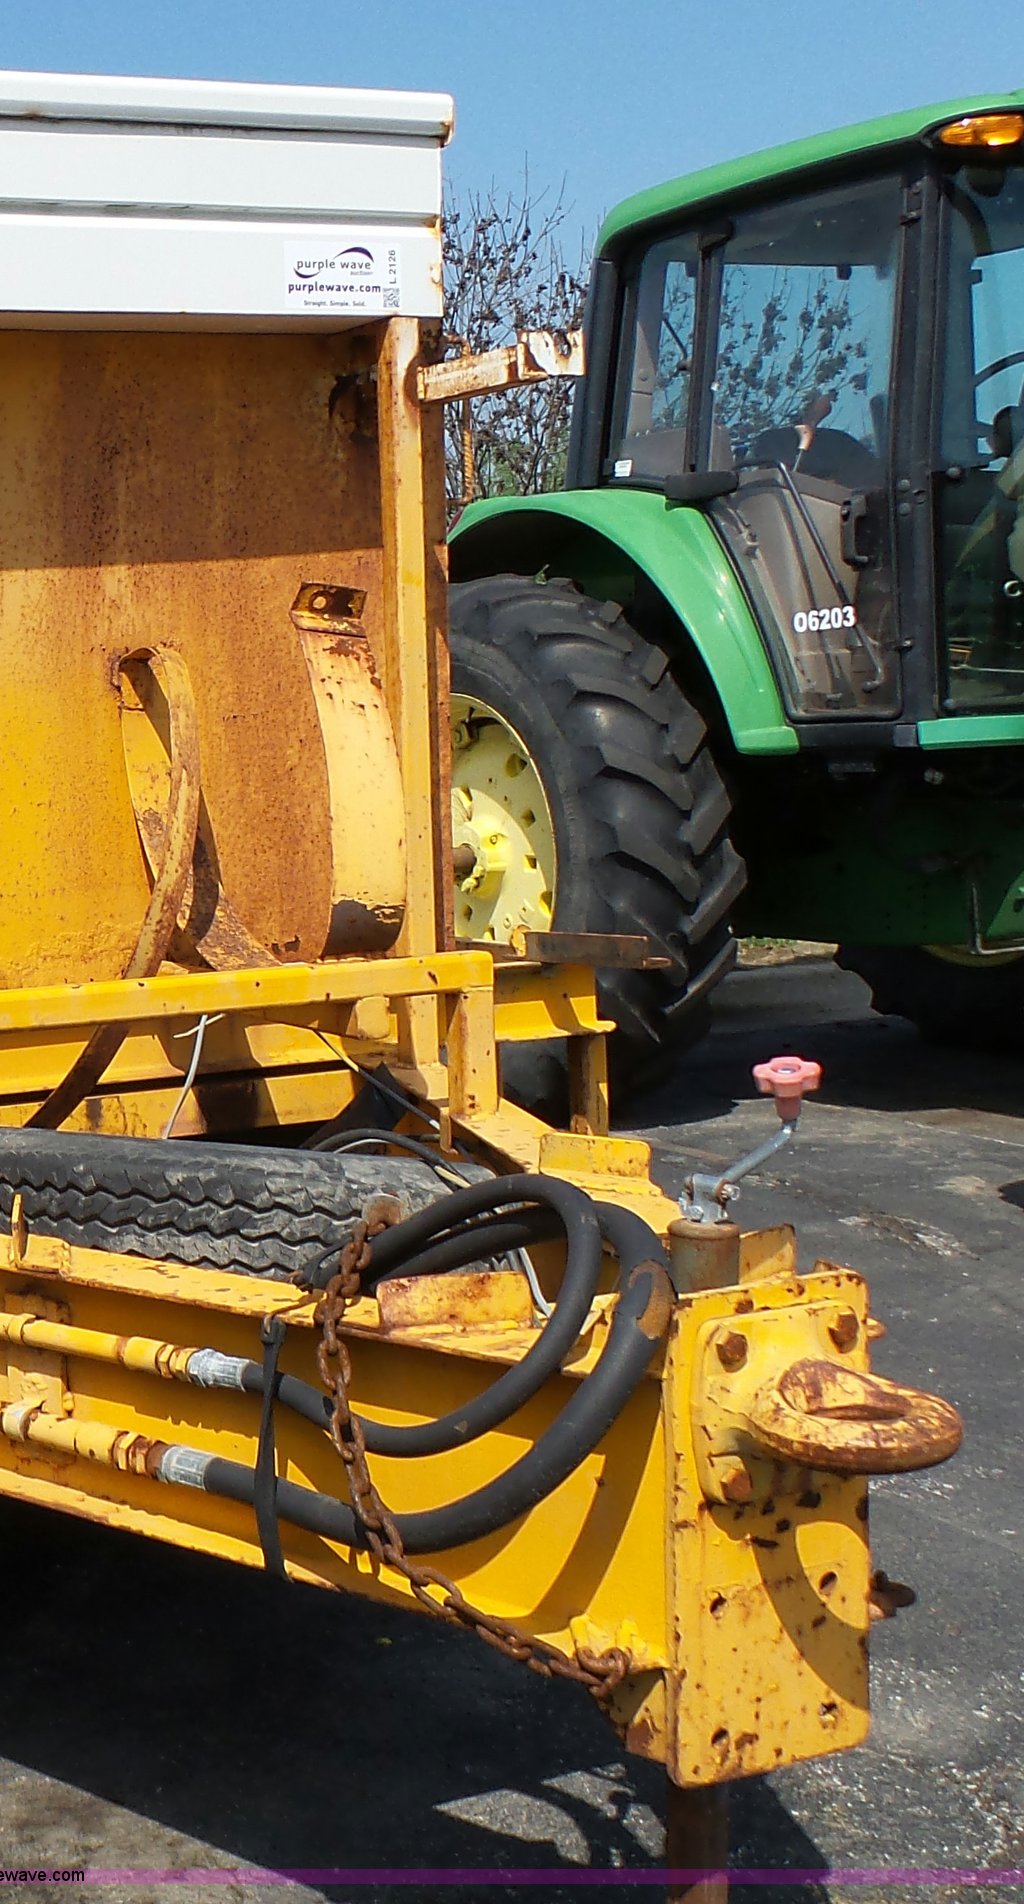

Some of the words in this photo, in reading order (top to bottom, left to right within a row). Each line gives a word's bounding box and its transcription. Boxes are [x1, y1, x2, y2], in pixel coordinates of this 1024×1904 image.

[296, 259, 336, 270] purple
[340, 261, 372, 270] wave
[388, 250, 397, 275] 2126
[288, 281, 381, 294] purplewave.com
[793, 605, 856, 633] 06203
